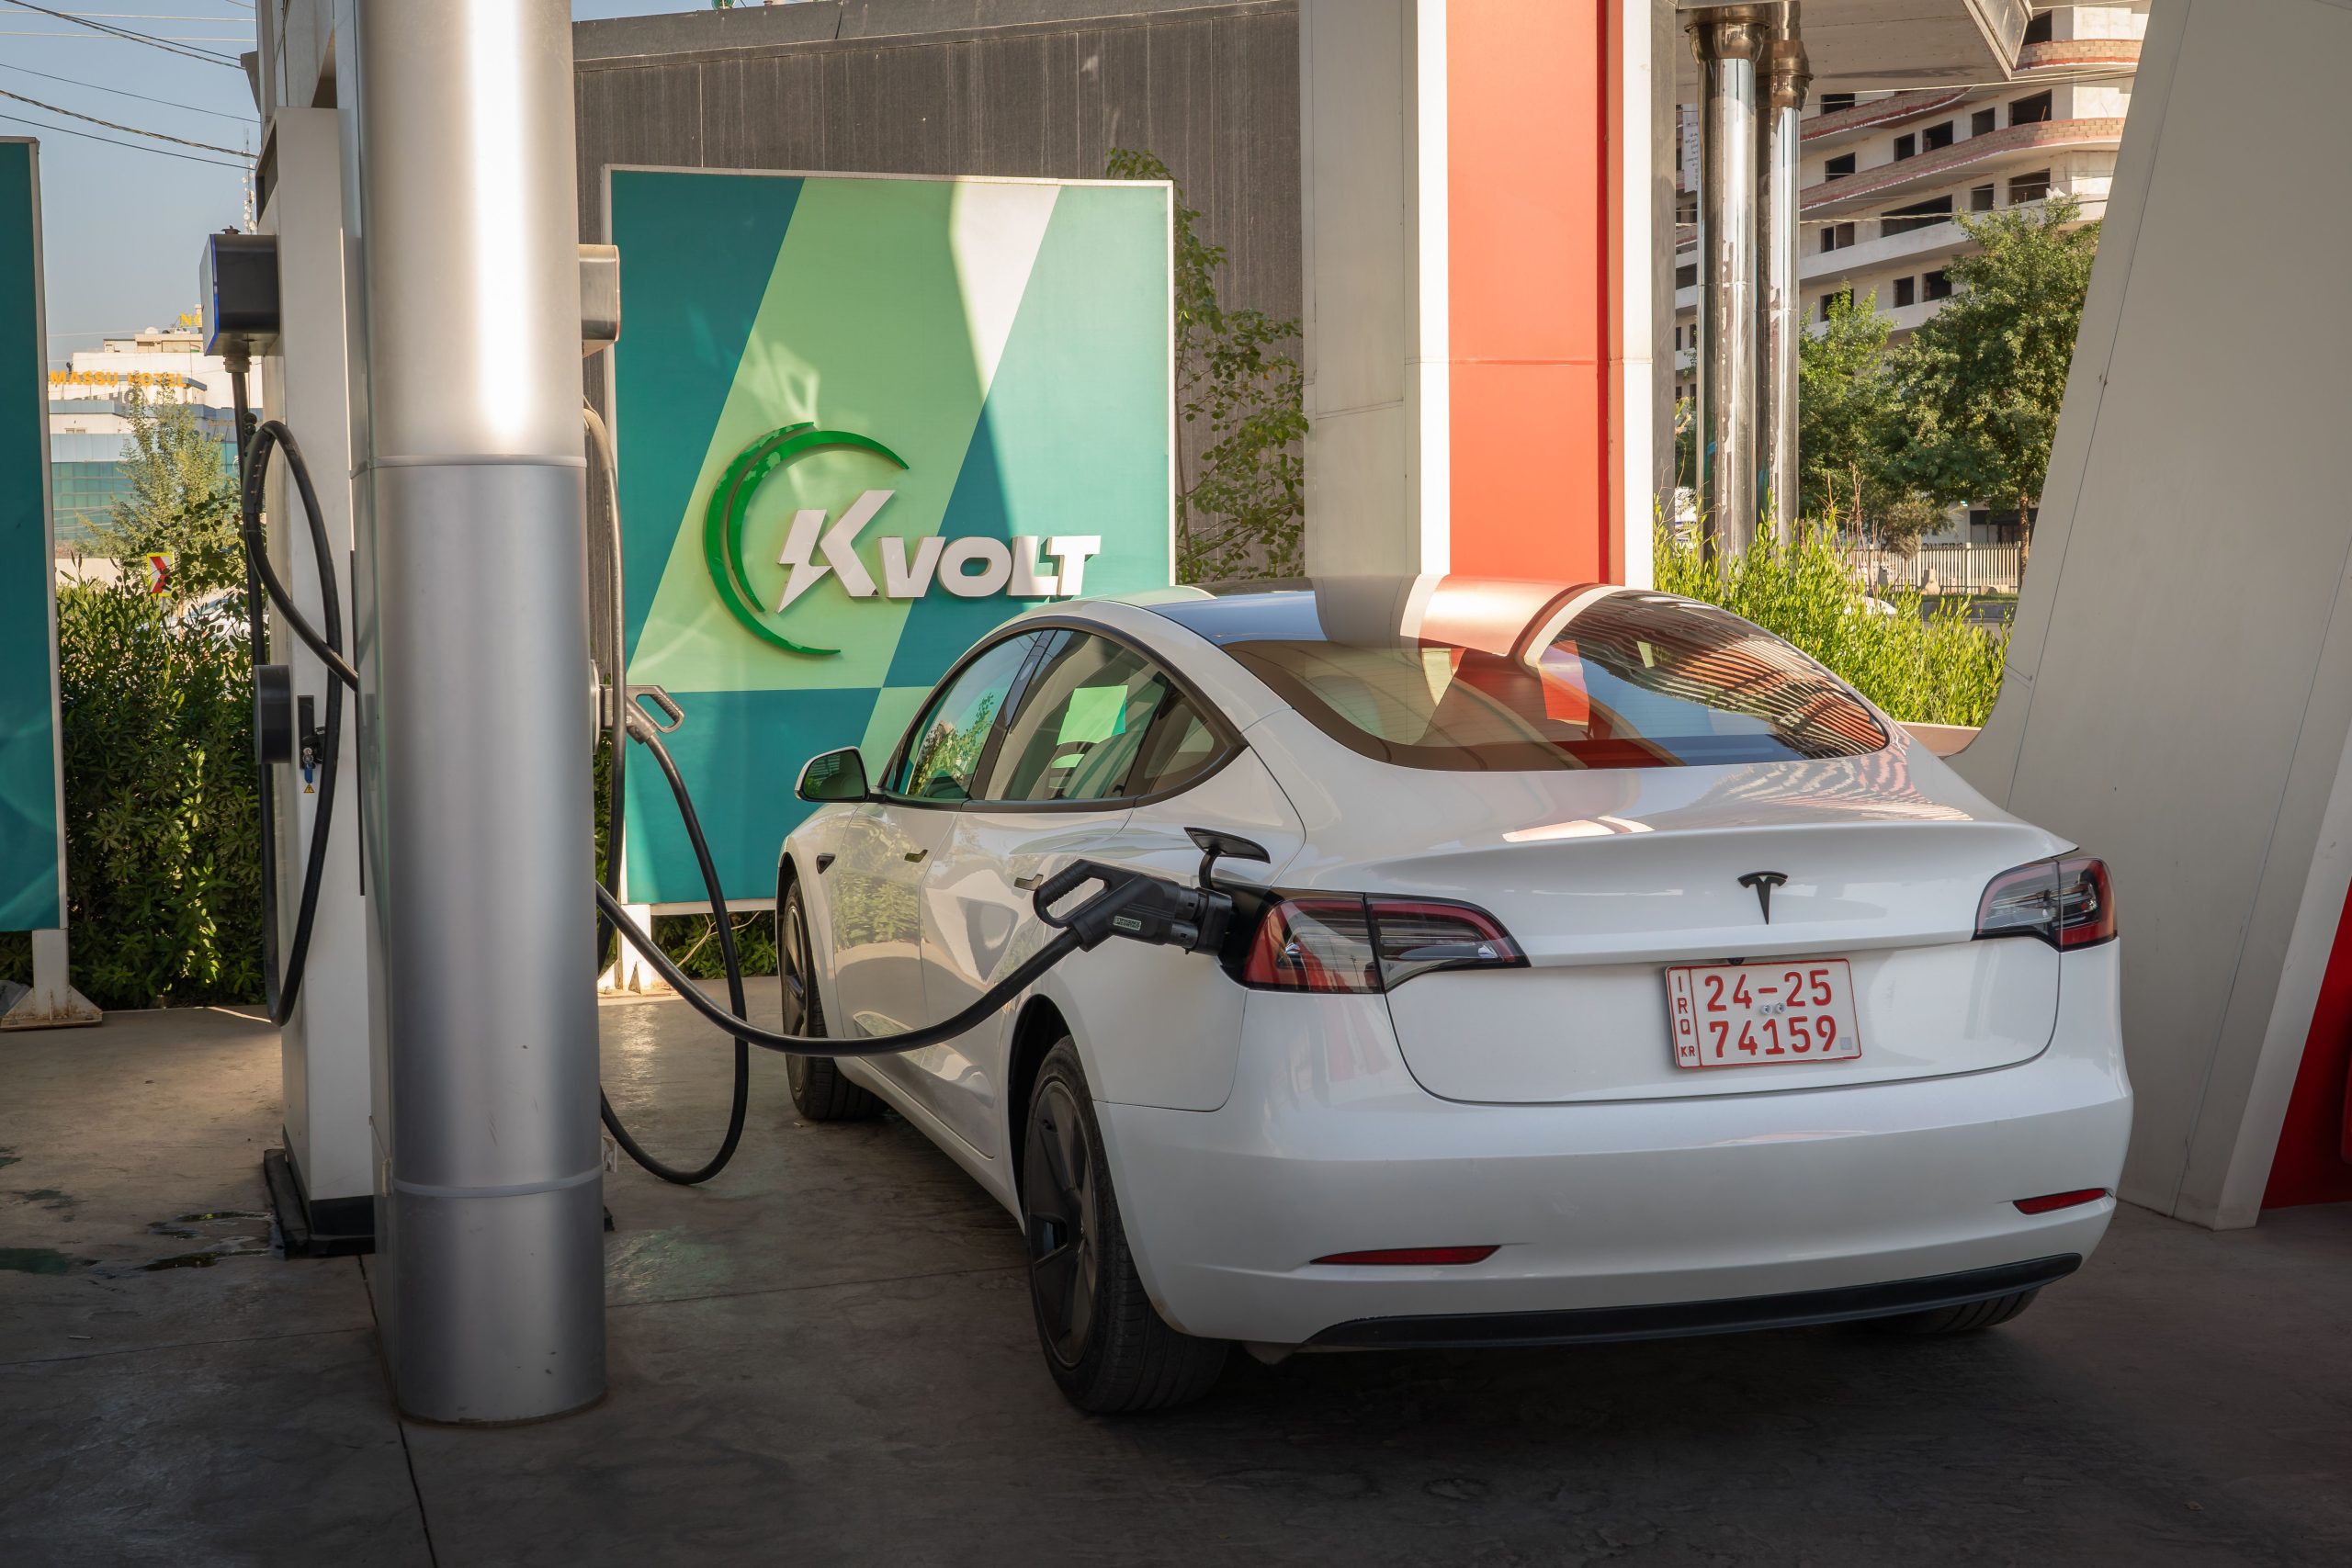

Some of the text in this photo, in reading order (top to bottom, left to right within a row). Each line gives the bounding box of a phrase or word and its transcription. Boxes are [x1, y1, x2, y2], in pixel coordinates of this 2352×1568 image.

[50, 370, 119, 386] MASSU
[1704, 969, 1832, 1011] 24-25
[1680, 1045, 1696, 1057] KR
[1709, 1015, 1838, 1058] 74159
